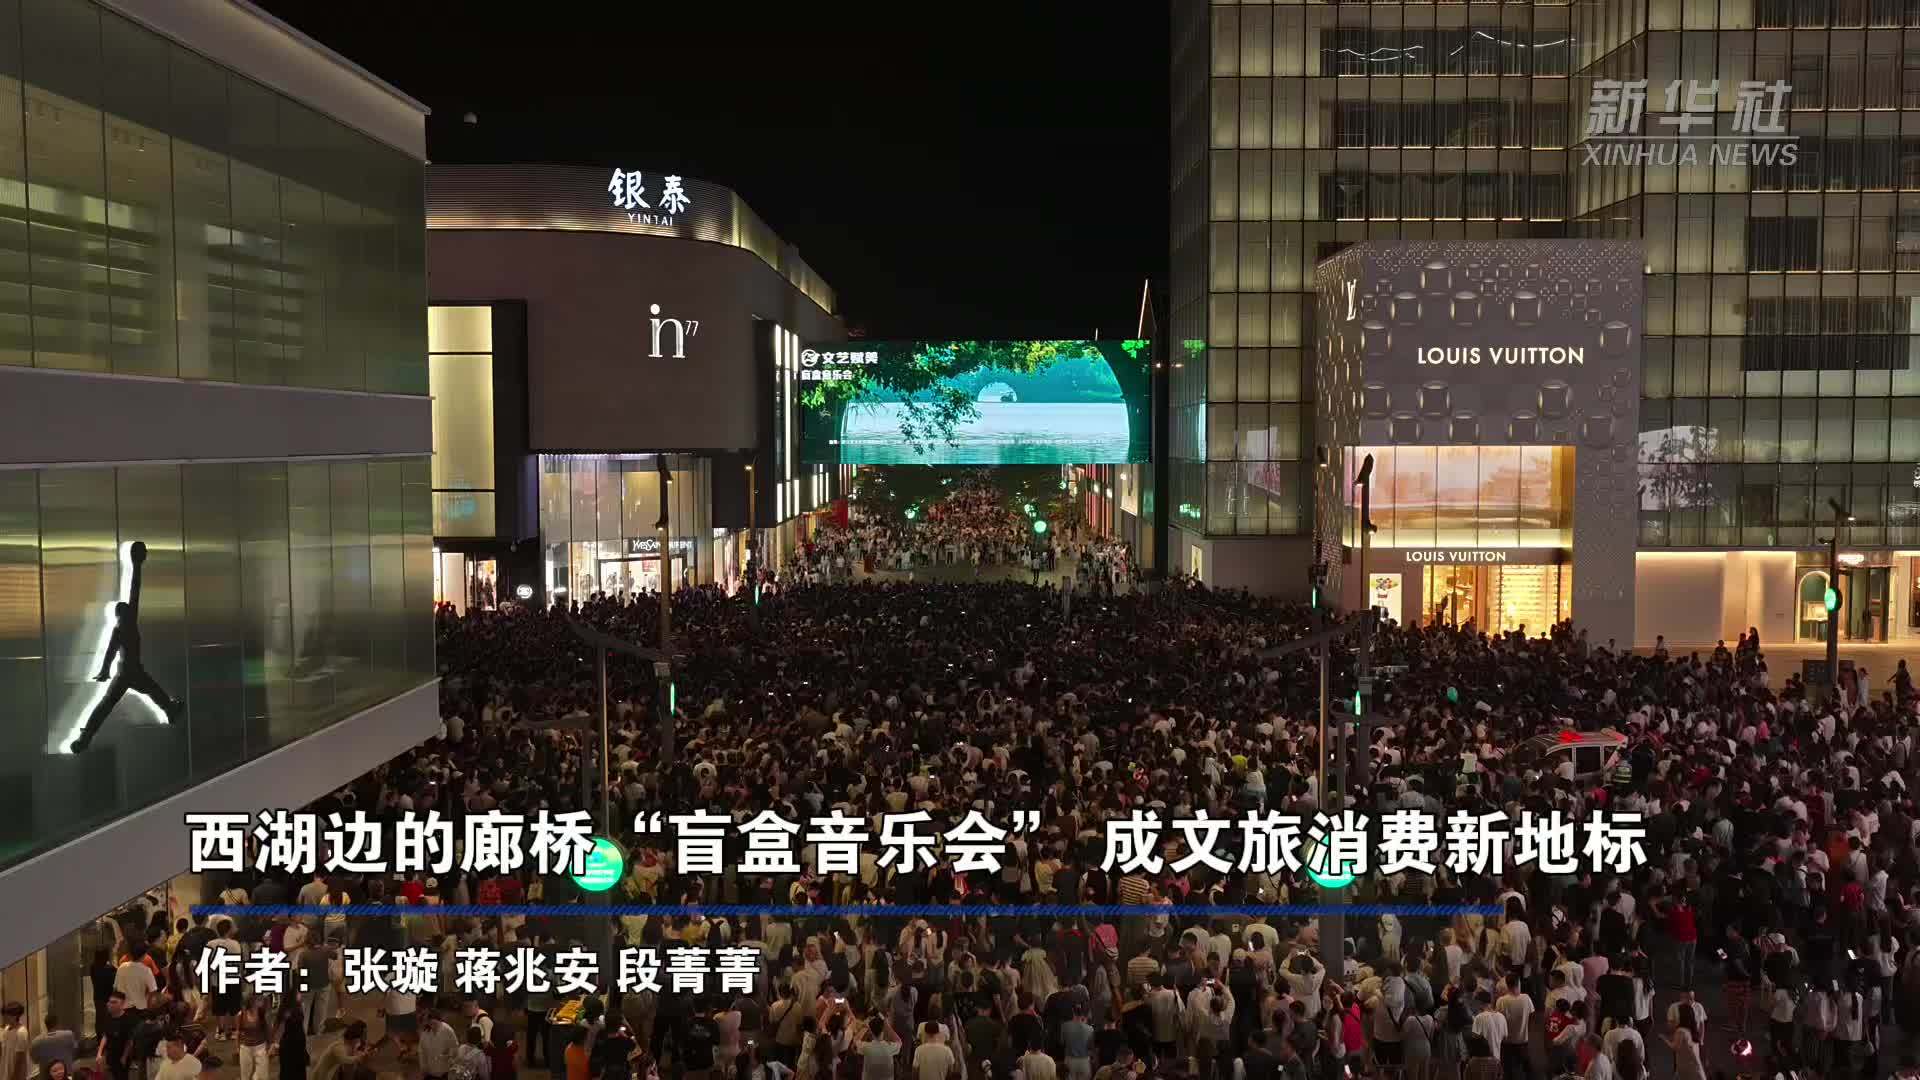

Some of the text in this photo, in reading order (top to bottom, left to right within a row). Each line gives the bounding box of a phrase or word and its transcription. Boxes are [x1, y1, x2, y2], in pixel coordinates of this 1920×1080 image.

[608, 168, 691, 215] 银泰
[628, 212, 673, 226] YINTAI
[1417, 347, 1585, 365] LOUIS VUITTON
[1406, 551, 1507, 562] LOUIS VUITTON
